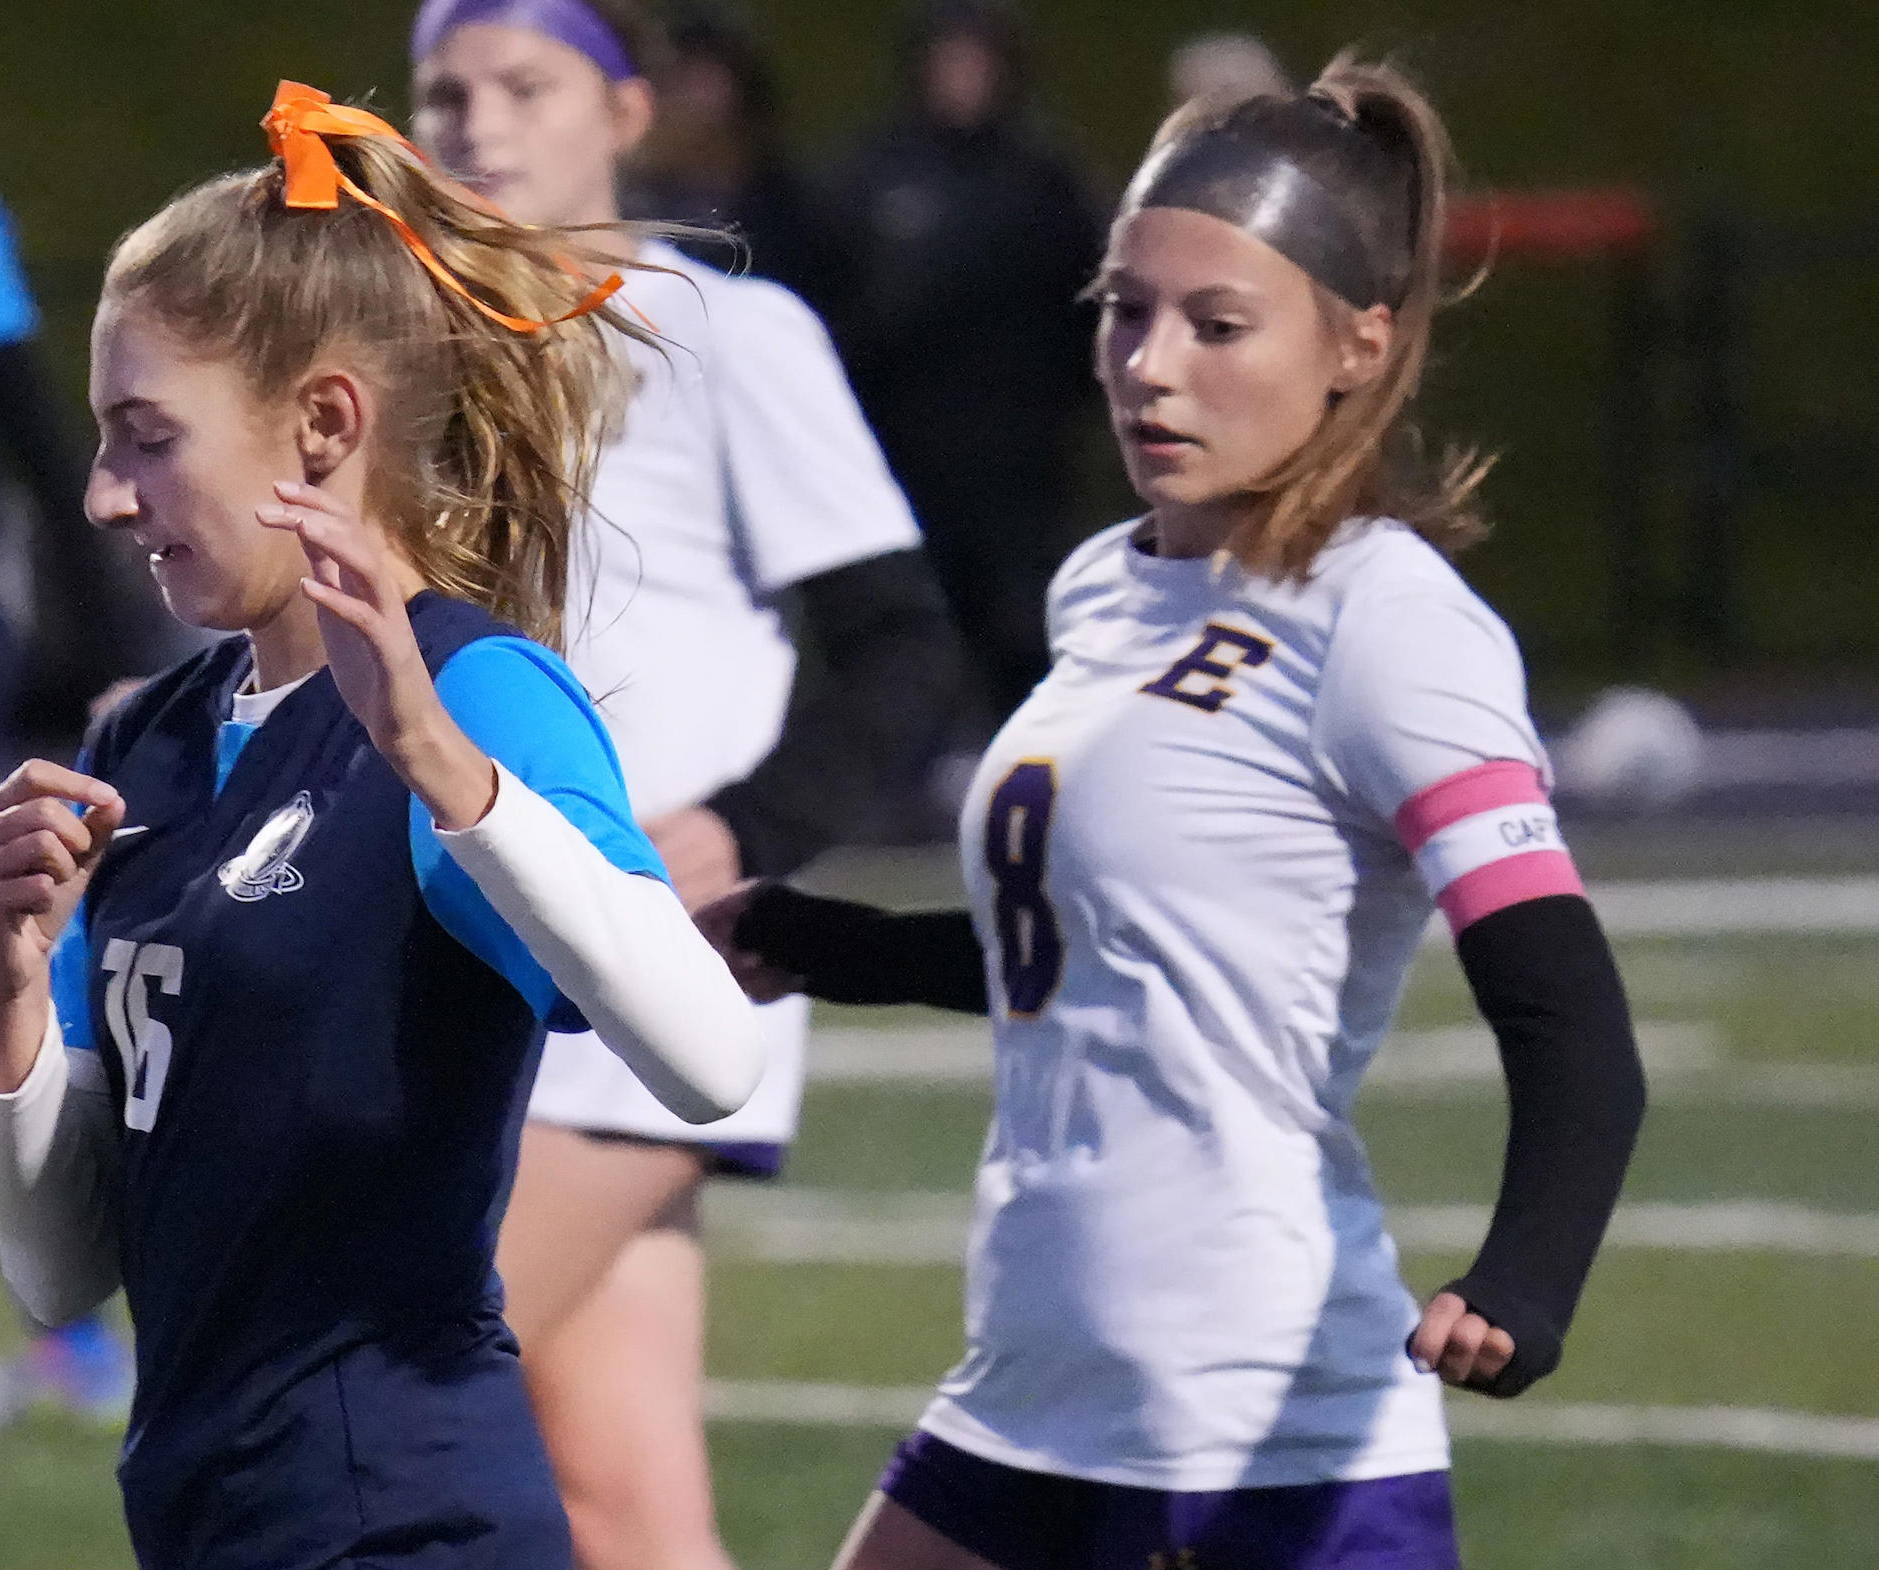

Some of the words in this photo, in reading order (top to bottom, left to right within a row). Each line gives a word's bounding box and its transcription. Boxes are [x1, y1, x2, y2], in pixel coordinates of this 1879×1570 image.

[1138, 622, 1273, 714] E
[985, 756, 1066, 1019] 8
[101, 937, 185, 1134] 16
